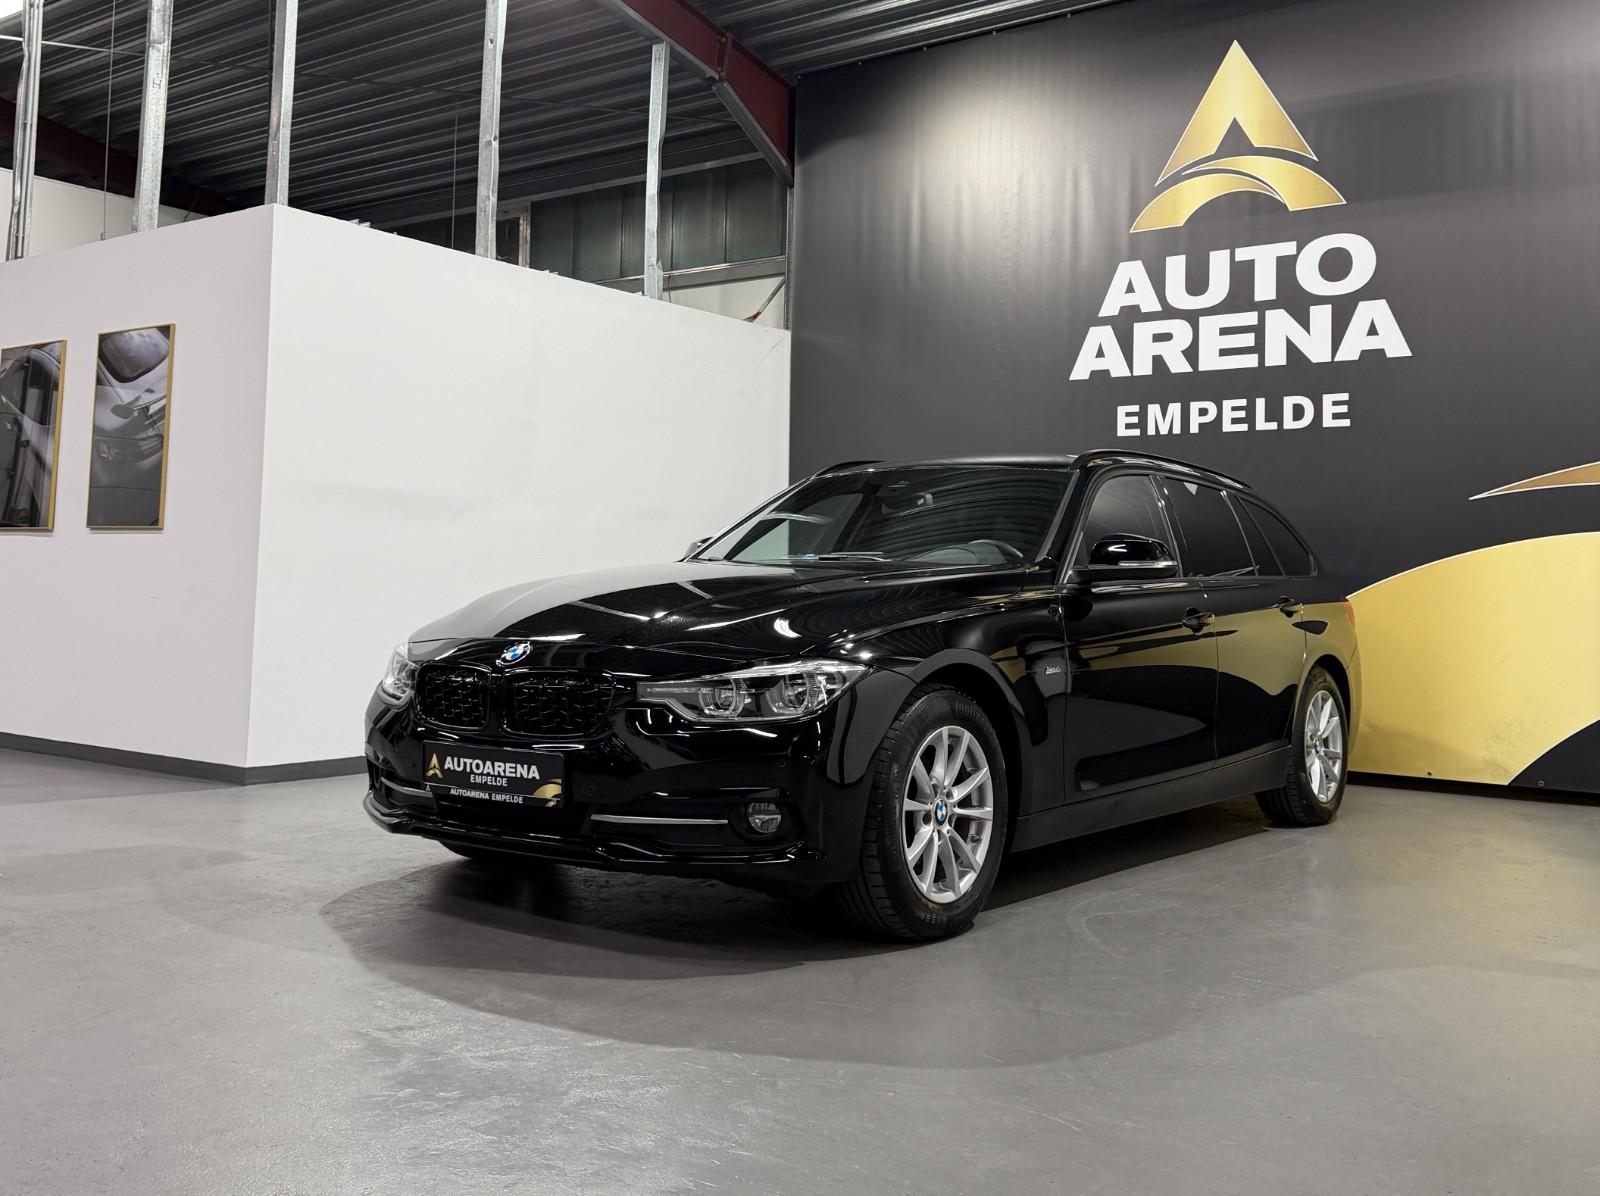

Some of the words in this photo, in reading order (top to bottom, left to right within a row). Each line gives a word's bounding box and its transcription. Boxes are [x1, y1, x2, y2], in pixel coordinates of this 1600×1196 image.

[1098, 233, 1377, 317] AUTO
[1069, 299, 1413, 381] ARENA
[1117, 393, 1351, 437] EMPELDE
[444, 756, 540, 779] AUTOARENA
[470, 774, 508, 786] EMPELDE
[450, 788, 490, 800] AUTOARENA
[491, 793, 524, 804] EMPELDE
